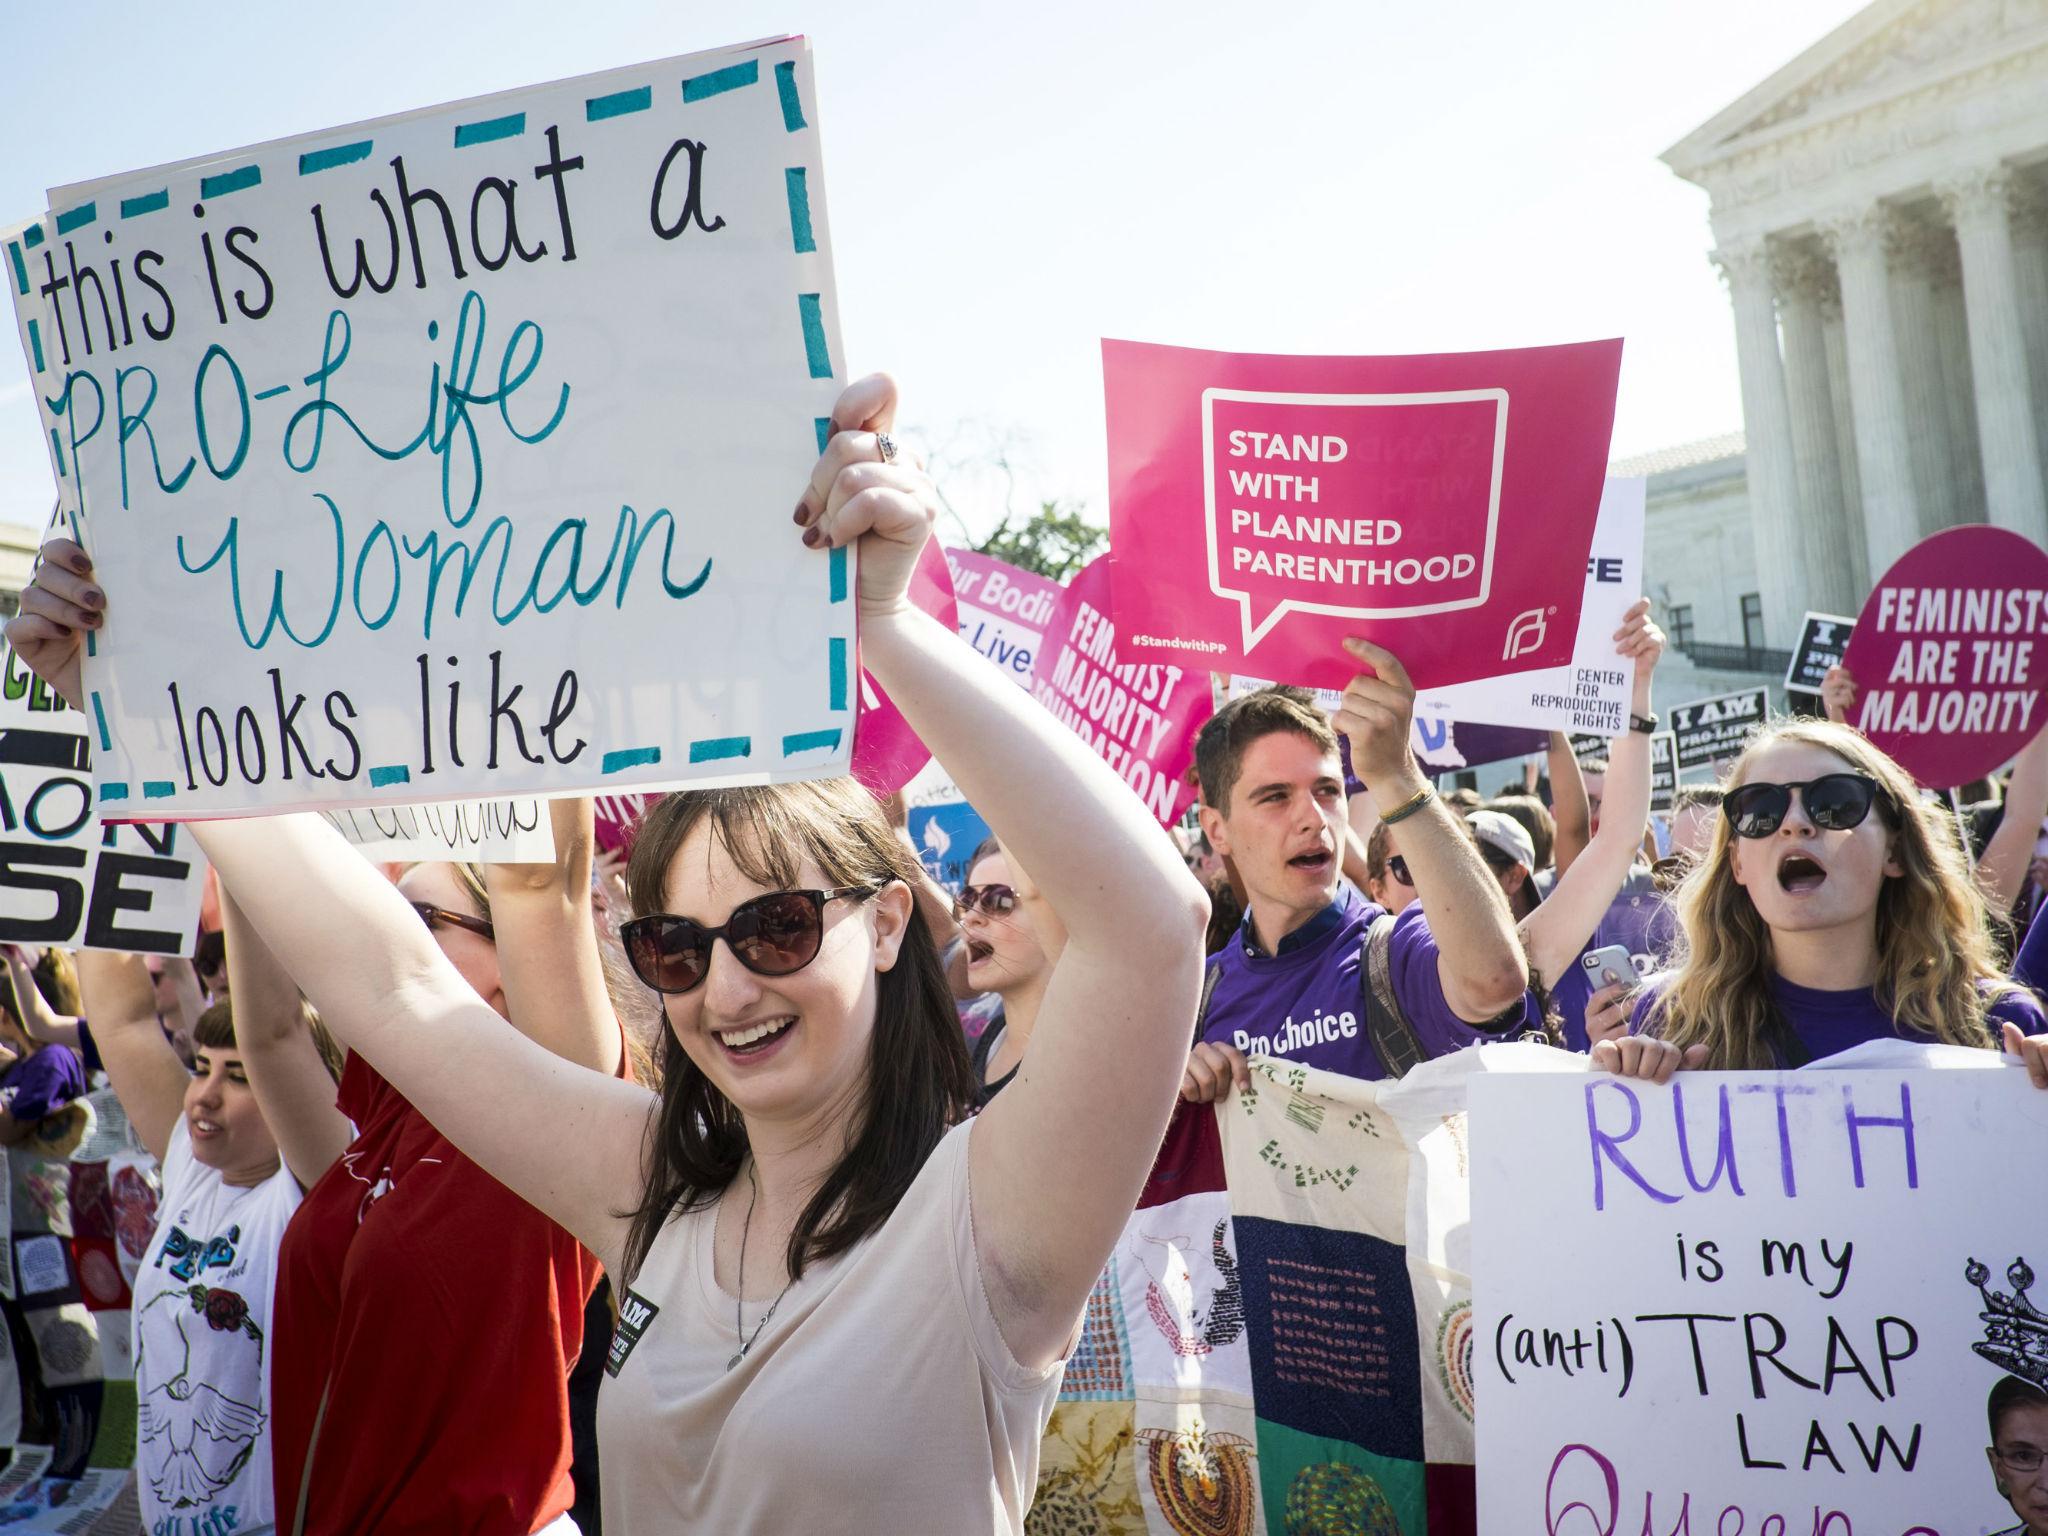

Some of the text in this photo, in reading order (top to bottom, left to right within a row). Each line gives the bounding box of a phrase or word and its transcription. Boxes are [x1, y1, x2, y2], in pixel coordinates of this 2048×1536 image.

[41, 125, 725, 364] this is what a
[1229, 430, 1348, 462] STAND
[1229, 469, 1319, 503] WITH
[1231, 509, 1402, 546] PLANNED
[177, 493, 713, 650] Woman
[1232, 546, 1476, 586] PARENTHOOD
[1132, 635, 1227, 655] #StandwithPP
[1888, 640, 2034, 684] ARE THE
[1576, 682, 1600, 698] FOR
[1577, 668, 1625, 686] CENTER
[168, 667, 362, 790] looks
[418, 650, 588, 773] like
[1052, 645, 1172, 760] MAJORITY
[1531, 694, 1623, 716] REPRODUCTIVE
[1572, 712, 1621, 731] RIGHTS
[1697, 694, 1759, 726] AM
[1858, 689, 2039, 734] MAJORITY
[1233, 1028, 1270, 1056] Pro
[1585, 1079, 1918, 1211] RUTH
[1676, 1232, 1853, 1299] is my
[1737, 1412, 1921, 1473] LAW
